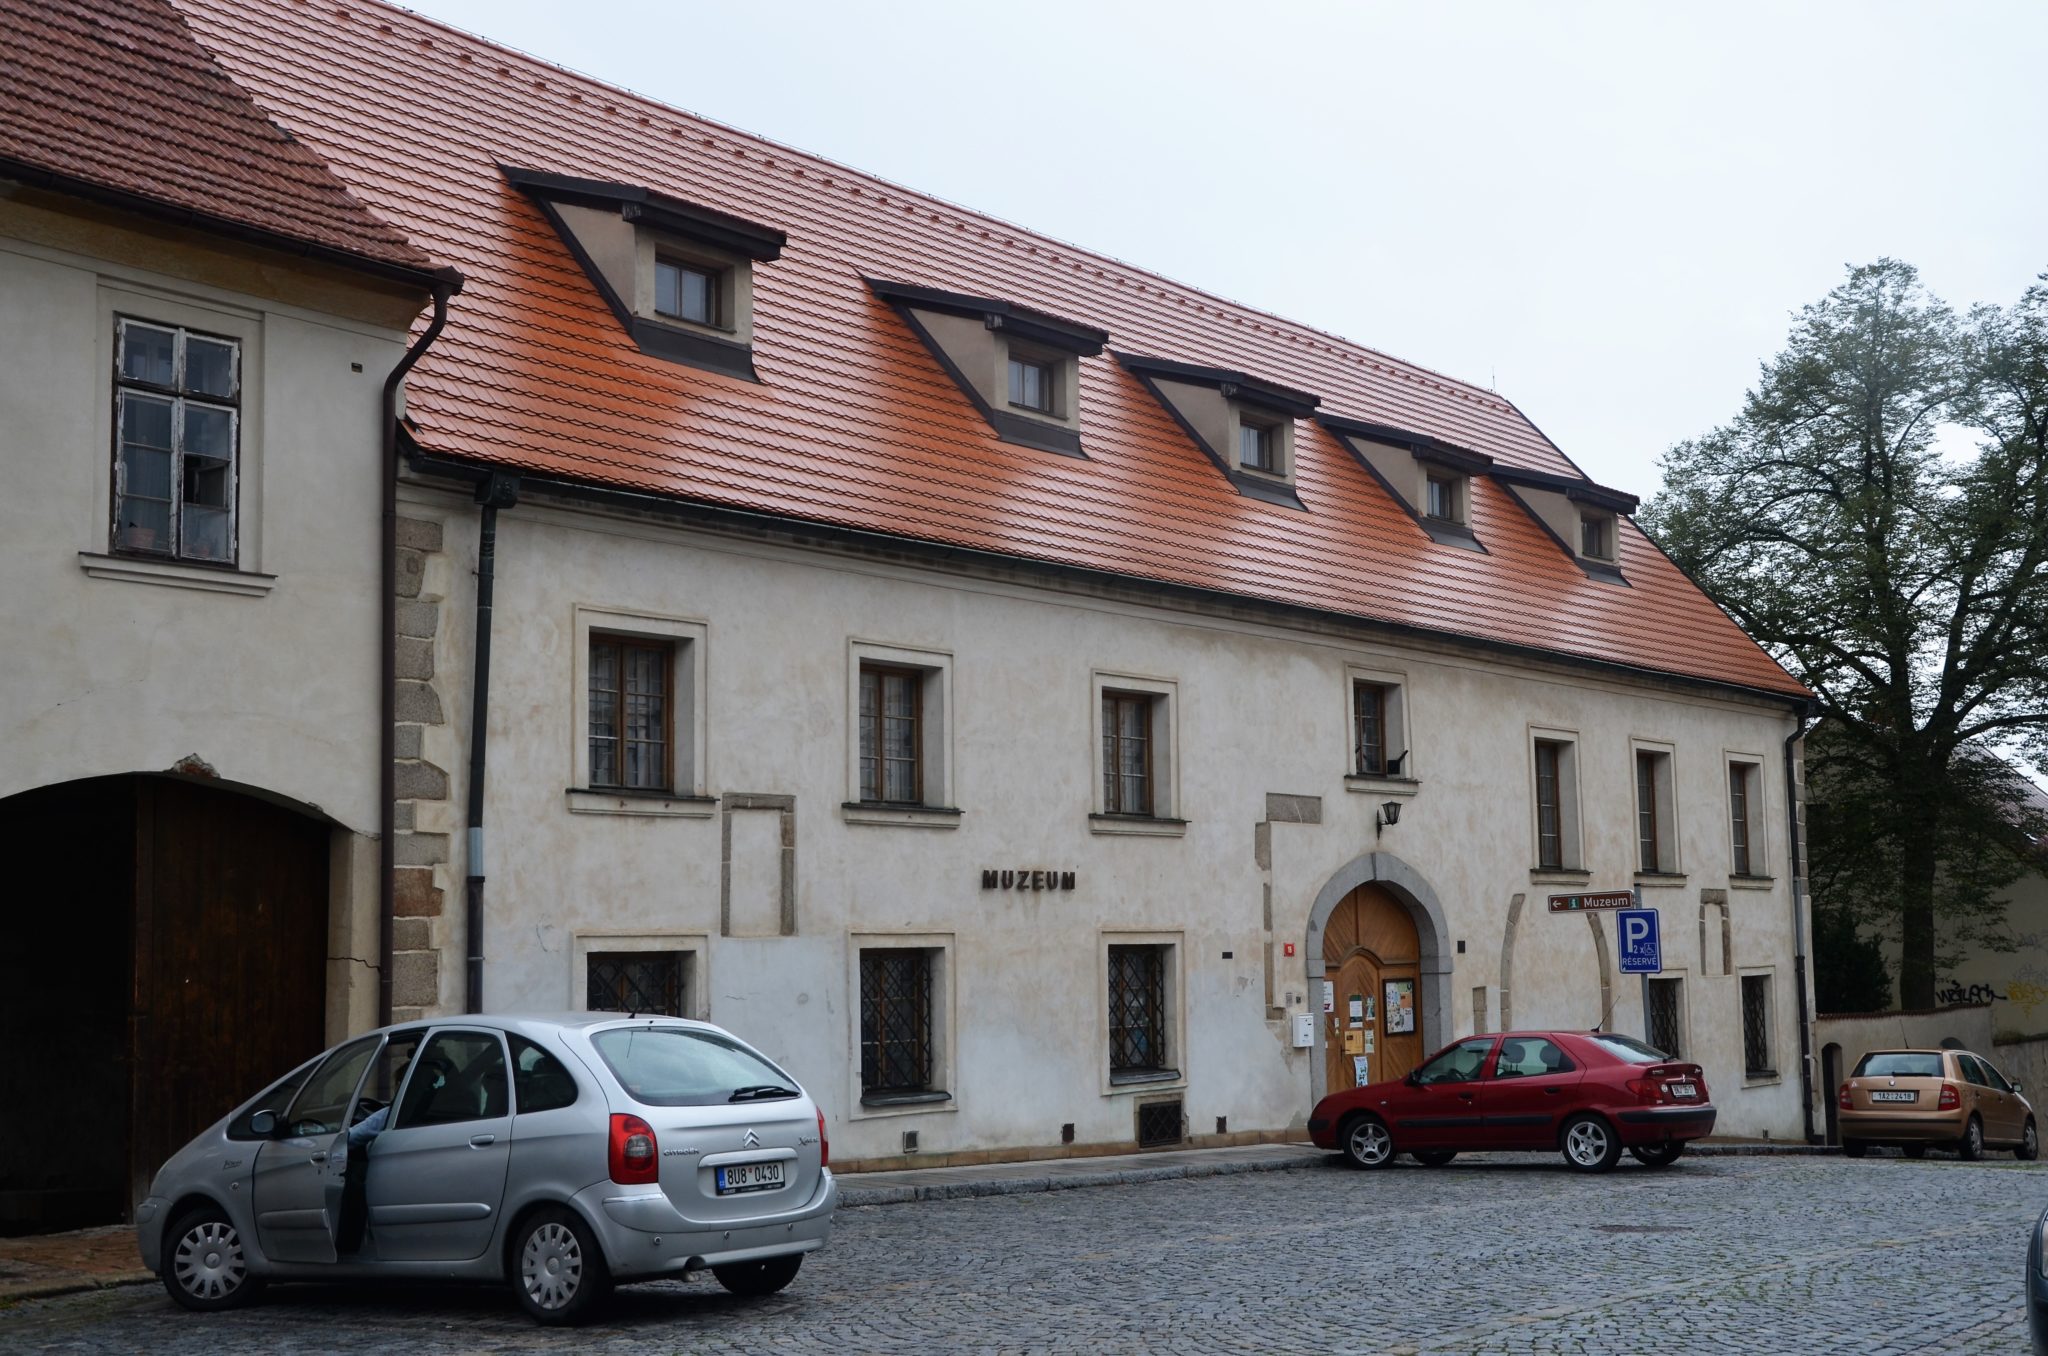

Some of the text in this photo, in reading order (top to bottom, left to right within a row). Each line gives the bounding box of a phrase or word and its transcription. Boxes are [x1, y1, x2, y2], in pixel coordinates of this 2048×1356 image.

[982, 869, 1076, 890] MUZEUM
[1584, 897, 1628, 908] Muzeum
[1626, 918, 1649, 953] P
[1634, 945, 1638, 954] 2
[1622, 957, 1657, 966] RÉSERVÉ
[727, 1163, 779, 1186] 8U8 0430
